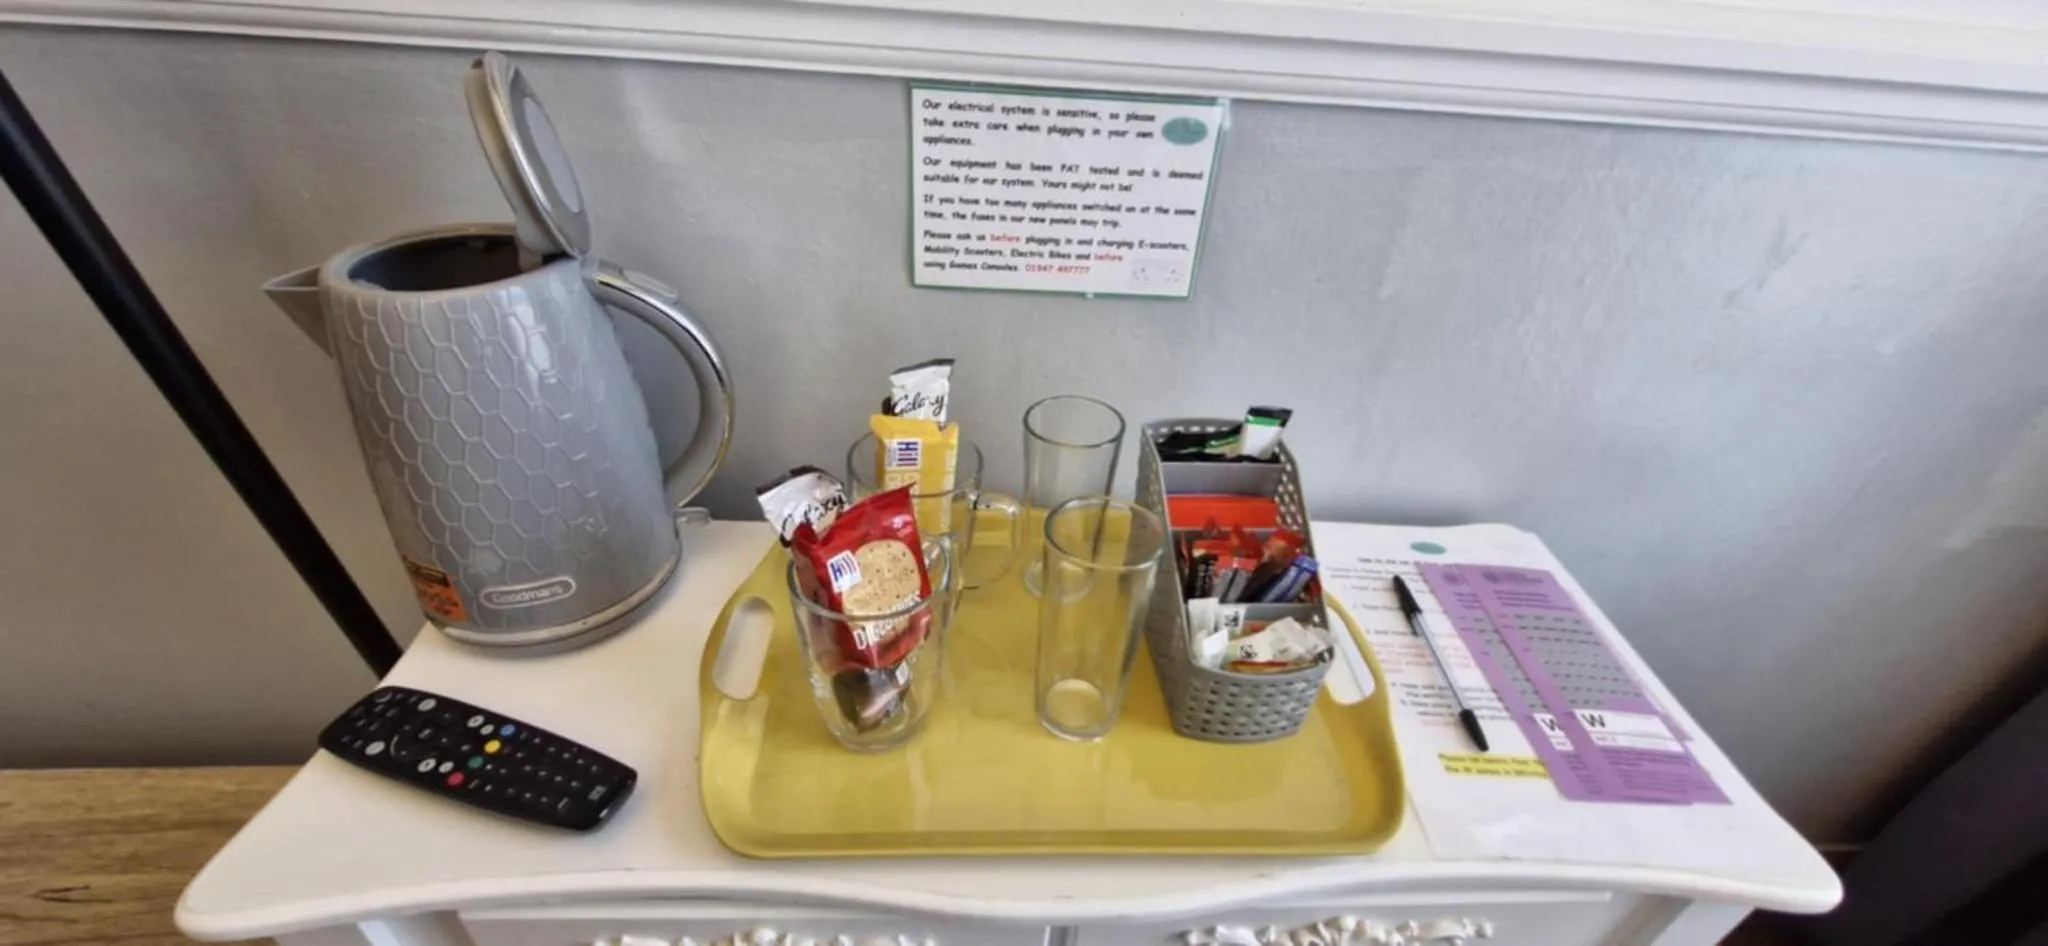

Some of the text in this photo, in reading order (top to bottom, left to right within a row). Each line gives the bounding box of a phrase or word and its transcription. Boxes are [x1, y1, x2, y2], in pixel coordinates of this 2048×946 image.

[922, 99, 1156, 123] Our electrical system is sensitive, so please
[923, 117, 944, 127] take
[952, 120, 980, 130] extra
[987, 123, 1008, 131] care
[1016, 123, 1040, 133] when
[1047, 124, 1085, 138] plugging
[1092, 127, 1101, 136] in
[1108, 129, 1129, 139] your
[922, 155, 1204, 180] Our equipment has been PAT tested and is deemed
[923, 174, 960, 184] suitable
[964, 174, 979, 185] for
[982, 177, 998, 186] our
[1042, 179, 1067, 189] Yours
[1070, 181, 1097, 193] might
[1099, 182, 1115, 191] not
[924, 193, 934, 204] If
[939, 197, 955, 206] you
[958, 196, 980, 206] have
[985, 197, 1000, 207] too
[1004, 199, 1027, 209] many
[1031, 200, 1078, 211] appliances
[1082, 203, 1122, 212] switched
[1154, 206, 1170, 215] the
[1174, 208, 1196, 216] same
[924, 210, 947, 219] time,
[952, 211, 967, 220] the
[971, 211, 995, 222] fuses
[999, 214, 1007, 222] in
[1010, 215, 1025, 224] our
[1029, 216, 1046, 224] new
[1049, 217, 1077, 226] panels
[1080, 218, 1098, 228] may
[923, 229, 952, 240] Please
[955, 232, 972, 241] ask
[975, 233, 987, 242] us
[990, 233, 1021, 243] before
[1024, 236, 1062, 247] plugging
[1064, 237, 1074, 246] in
[1076, 238, 1094, 247] and
[1096, 239, 1135, 250] charging
[923, 245, 960, 256] Mobility
[1010, 248, 1044, 258] Electric
[1048, 250, 1072, 260] Bikes
[1075, 252, 1092, 261] and
[1094, 253, 1123, 262] before
[922, 261, 947, 271] using
[948, 260, 979, 270] Games
[895, 441, 920, 467] Hill
[829, 553, 858, 583] Hill
[492, 584, 565, 604] Goodmans
[1581, 713, 1606, 729] W
